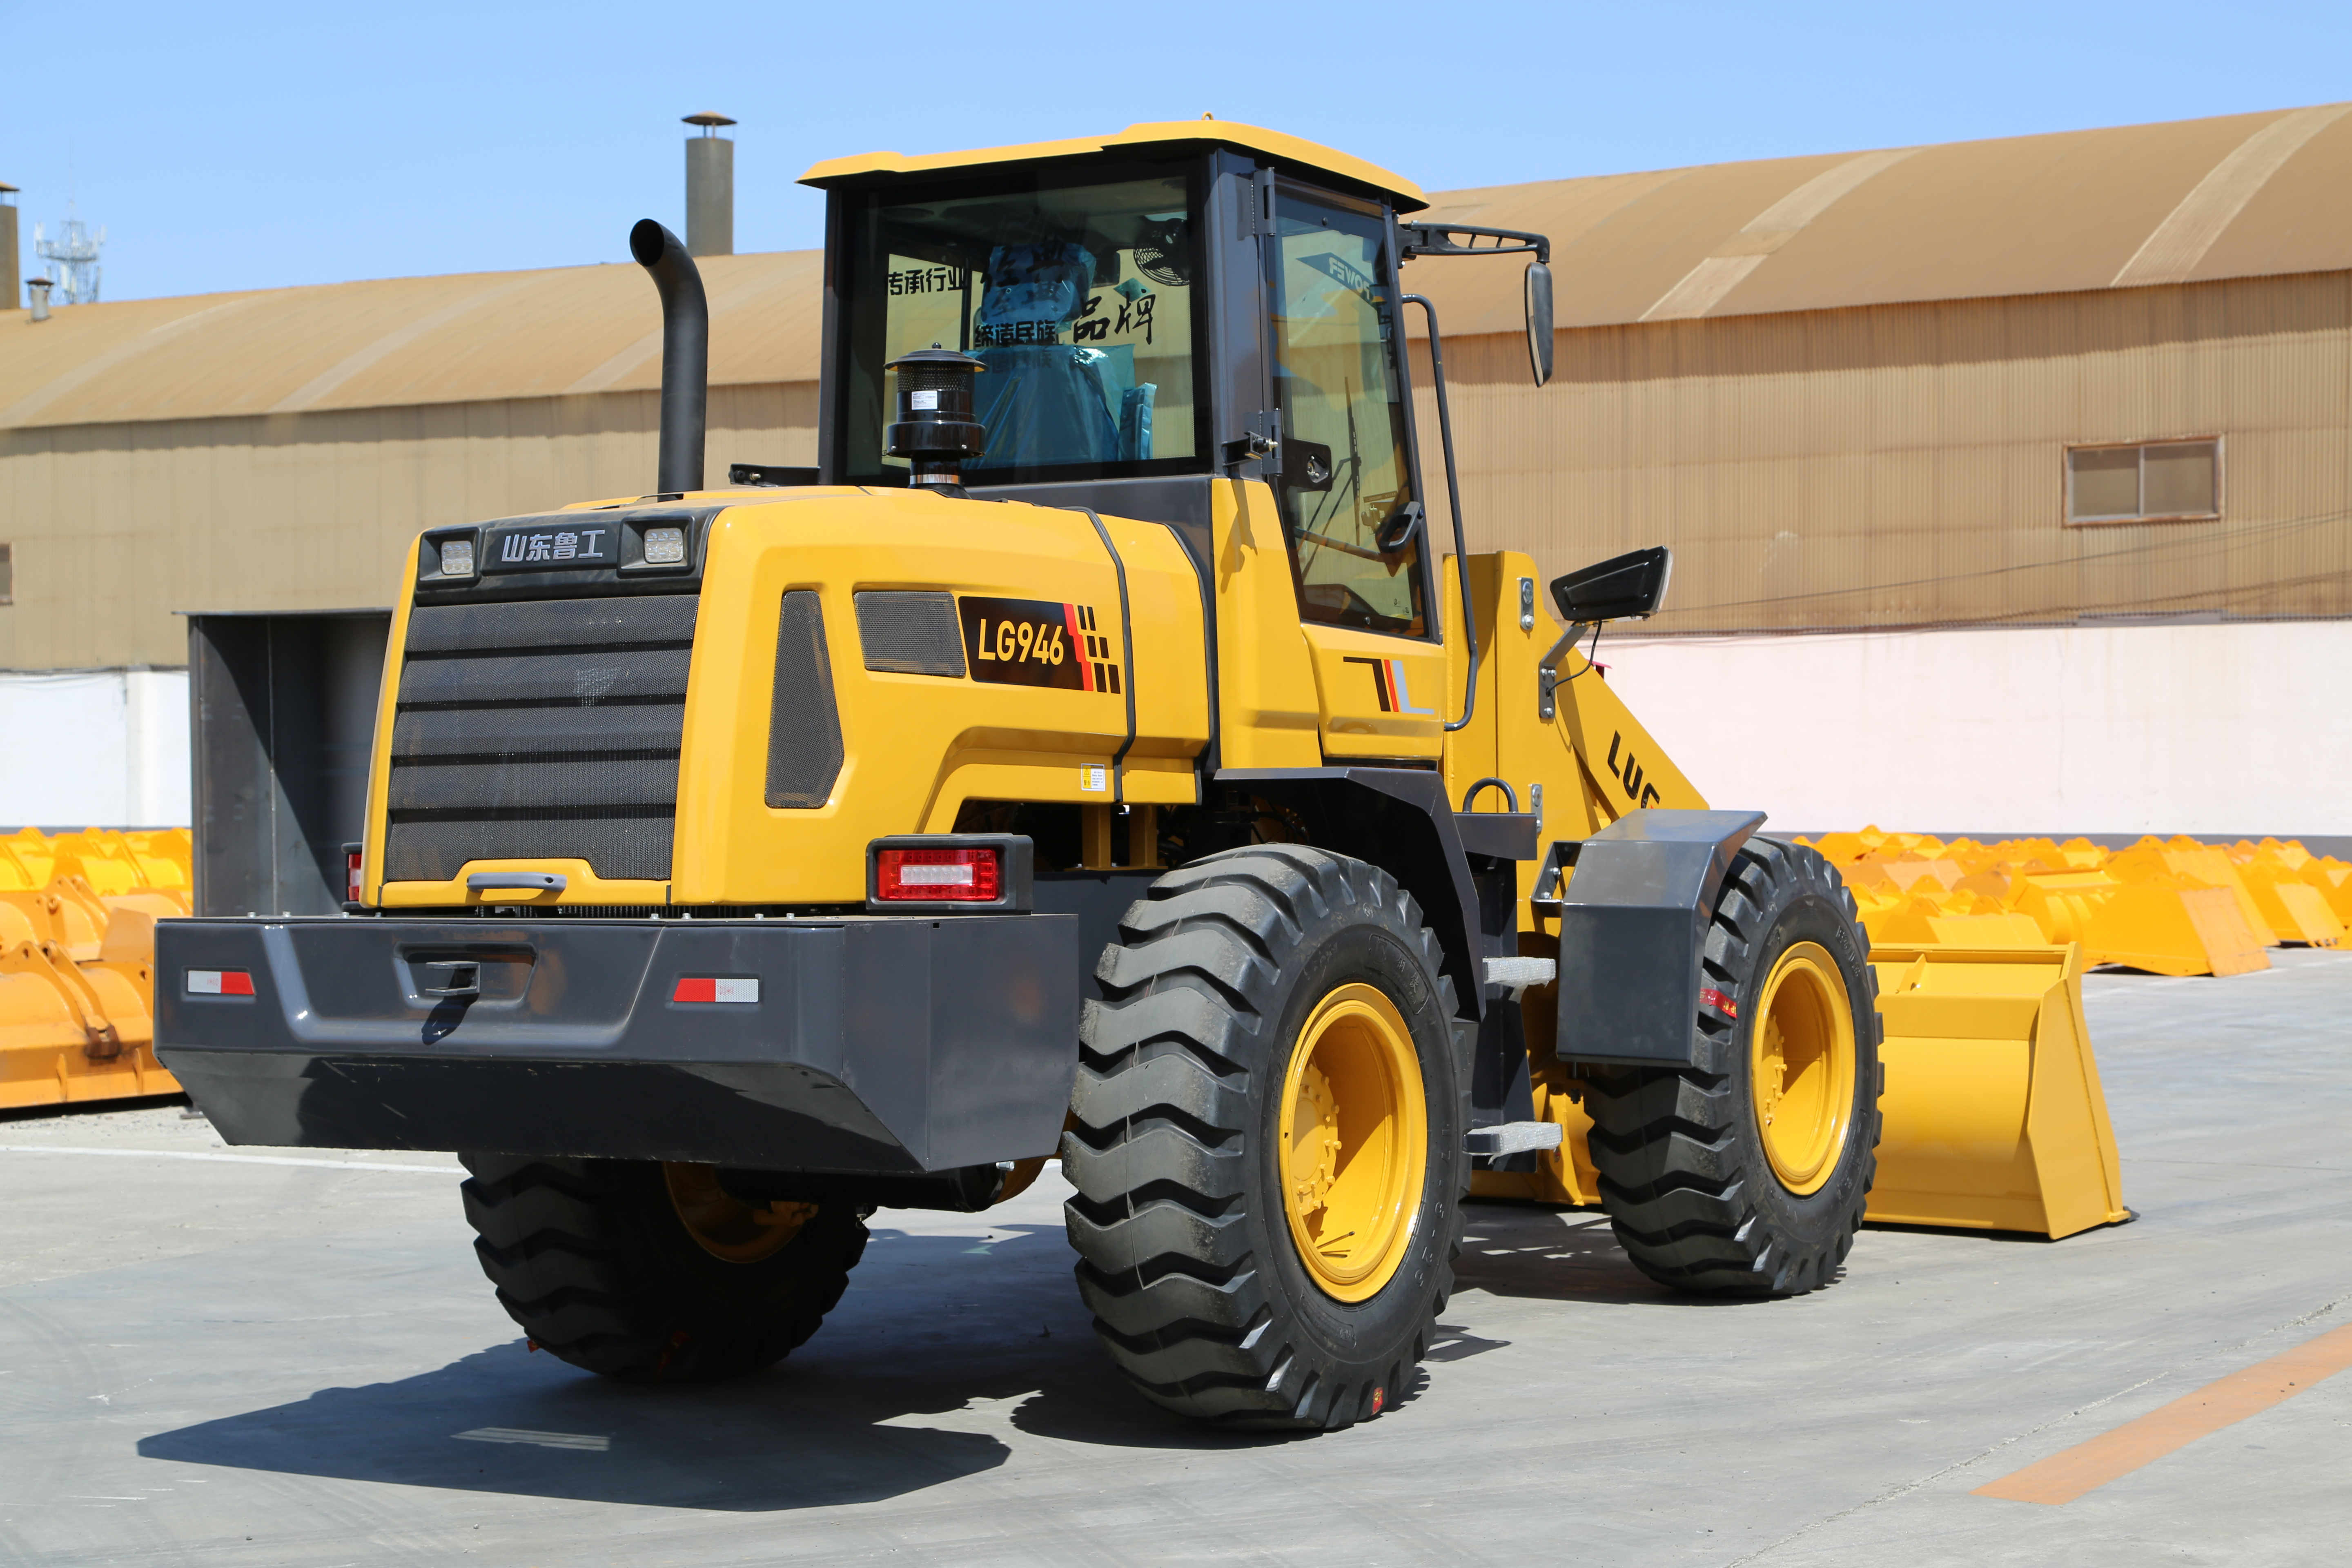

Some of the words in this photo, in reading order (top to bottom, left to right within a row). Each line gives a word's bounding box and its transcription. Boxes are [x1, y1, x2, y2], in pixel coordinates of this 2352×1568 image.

[885, 267, 965, 296] 传承行业
[1073, 288, 1156, 345] 品牌
[501, 529, 605, 562] 山东鲁工
[978, 619, 1064, 665] LG946
